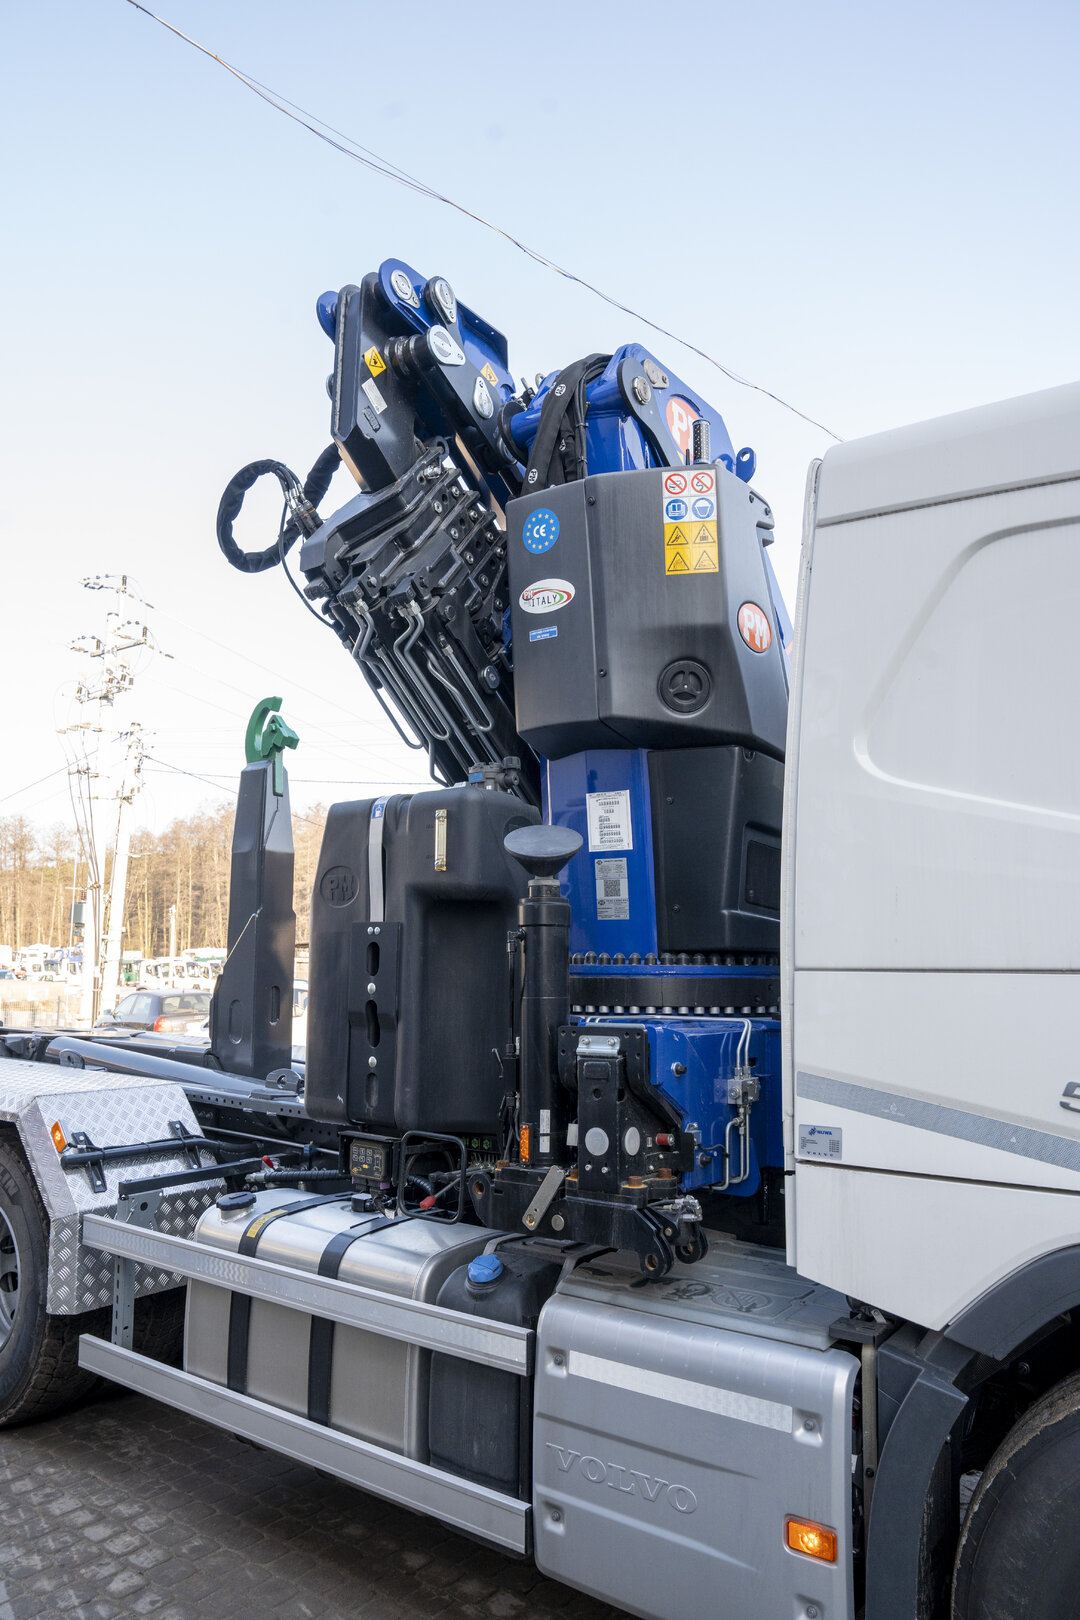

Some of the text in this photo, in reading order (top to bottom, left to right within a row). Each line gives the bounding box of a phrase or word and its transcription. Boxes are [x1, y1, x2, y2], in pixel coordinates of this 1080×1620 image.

[533, 524, 546, 538] CE
[531, 594, 557, 607] ITALY
[743, 607, 770, 649] PM
[546, 1442, 698, 1514] VOLVO
